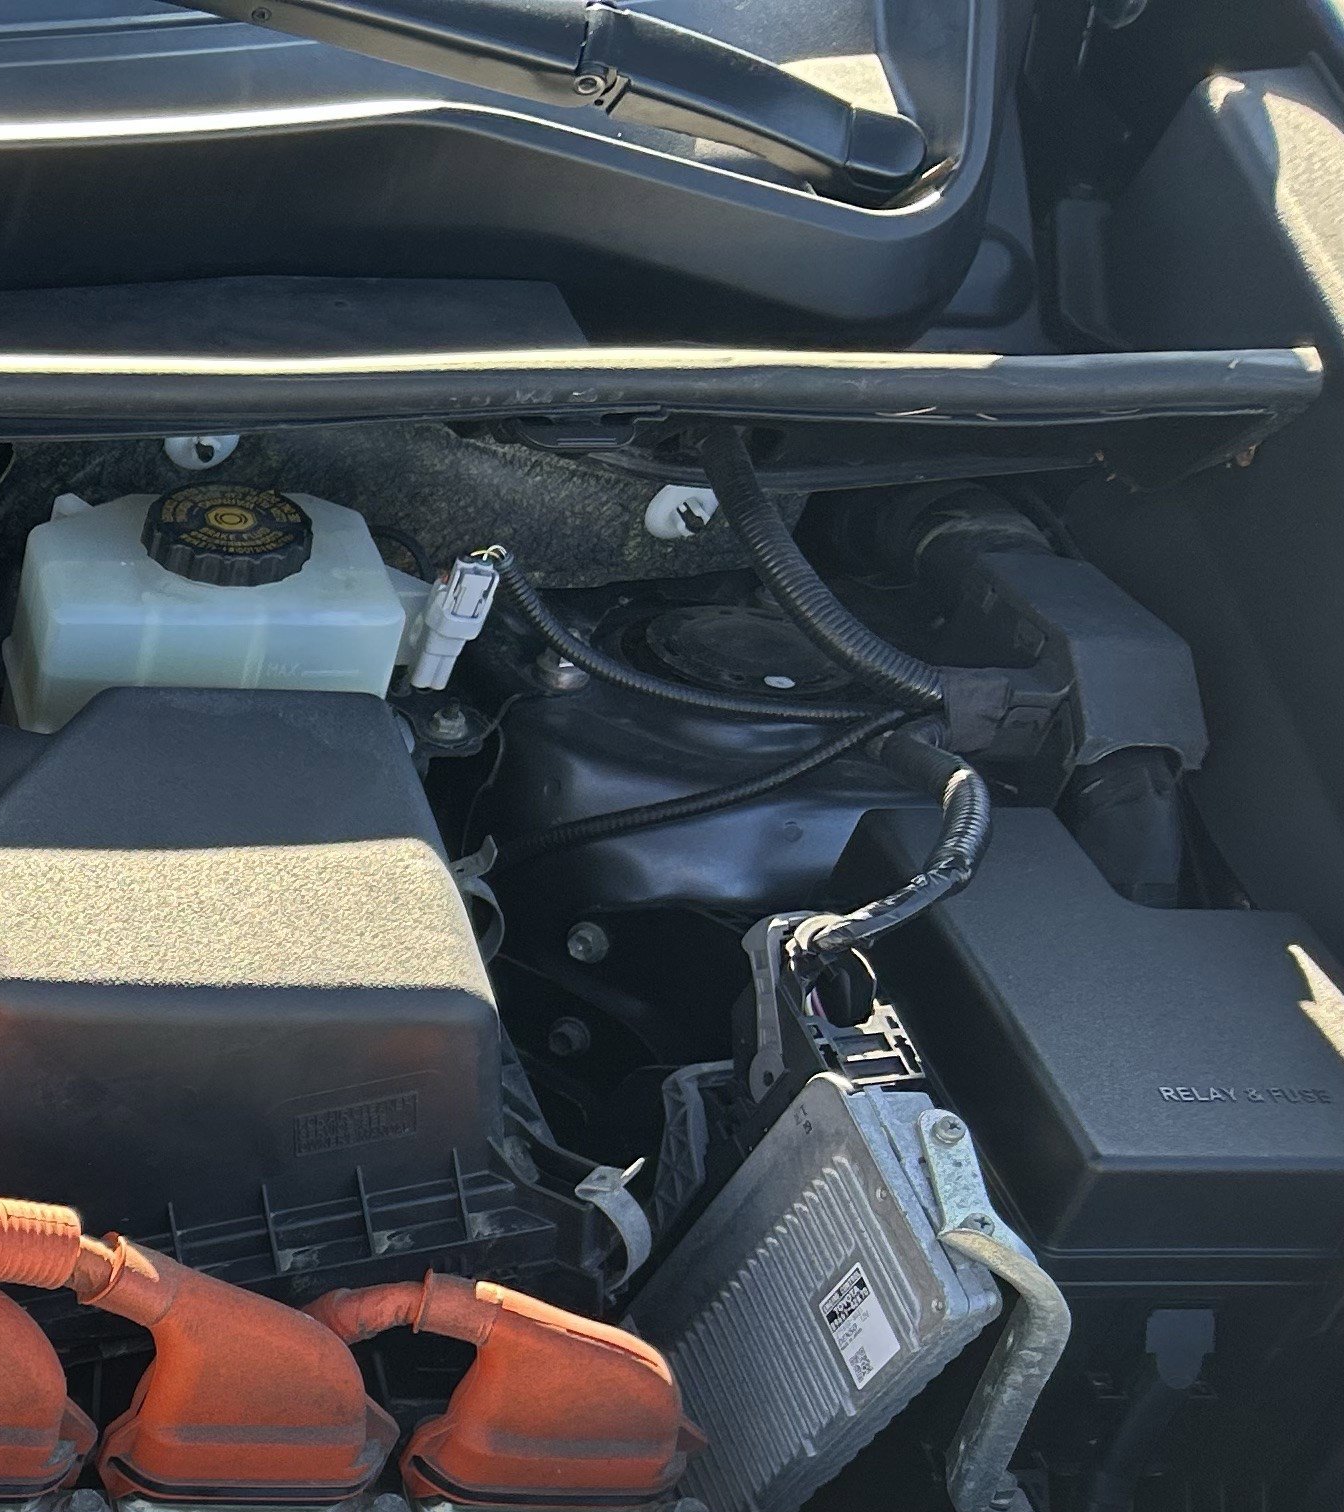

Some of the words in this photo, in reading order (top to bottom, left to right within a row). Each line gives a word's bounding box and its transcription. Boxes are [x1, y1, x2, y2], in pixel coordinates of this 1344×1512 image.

[1158, 1086, 1237, 1103] RELAY
[1245, 1088, 1265, 1104] &
[1267, 1088, 1332, 1105] FUSE
[834, 1286, 859, 1316] TOYOTA
